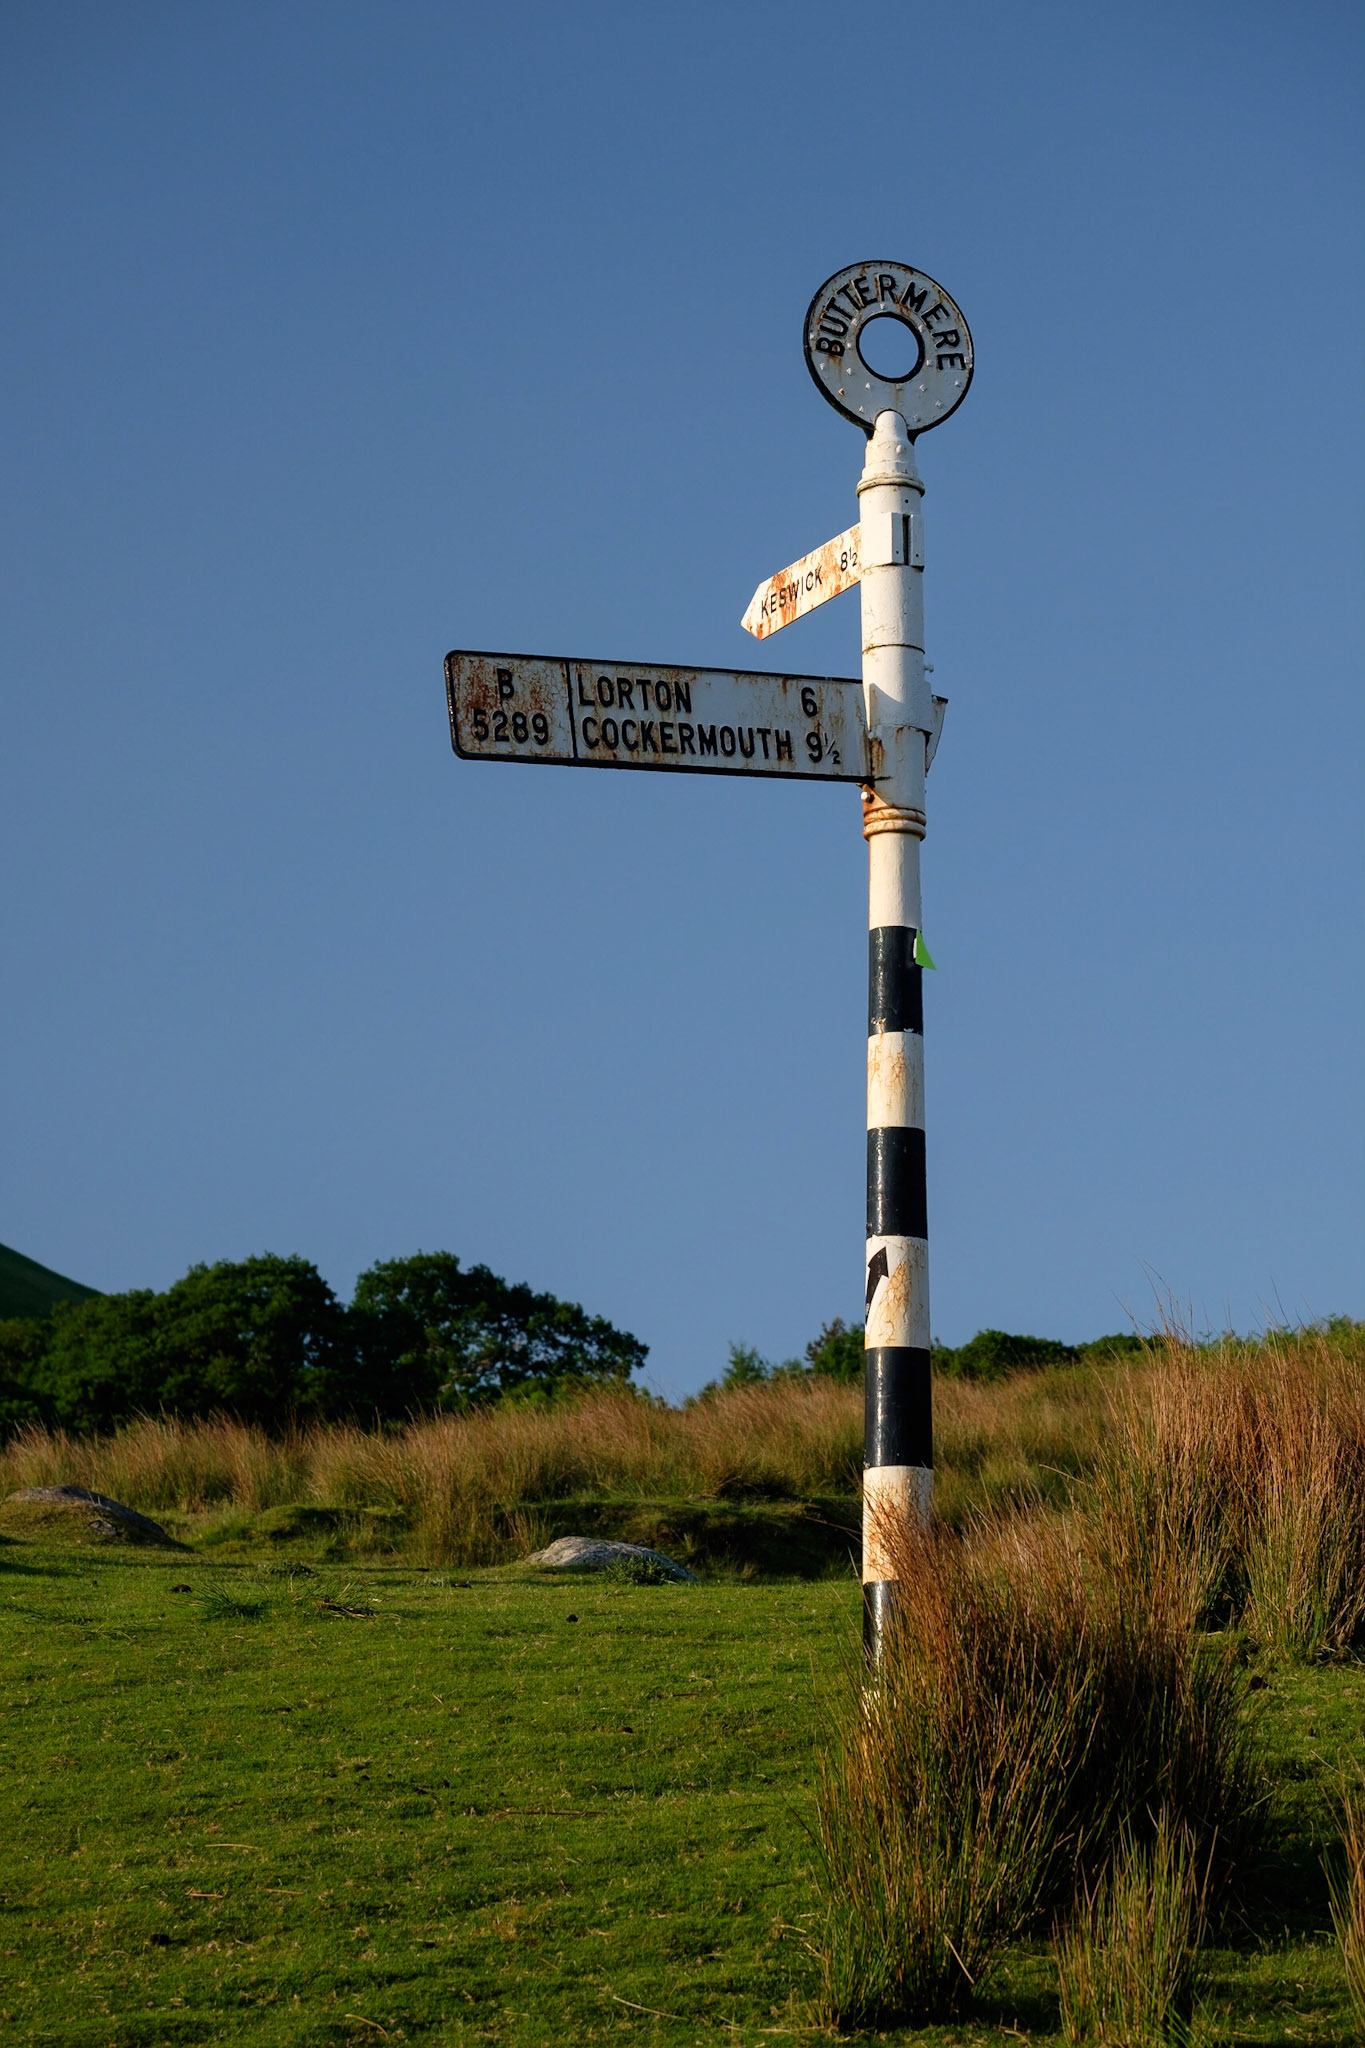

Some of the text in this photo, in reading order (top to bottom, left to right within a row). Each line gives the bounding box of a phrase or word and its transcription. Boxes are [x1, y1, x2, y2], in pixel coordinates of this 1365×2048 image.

[815, 273, 967, 371] BUTTERMERE
[761, 564, 823, 619] KESWICK
[497, 668, 515, 700] B
[577, 673, 818, 718] LORTON 6
[473, 708, 549, 746] 5289
[582, 716, 793, 761] COCKERMOUTH
